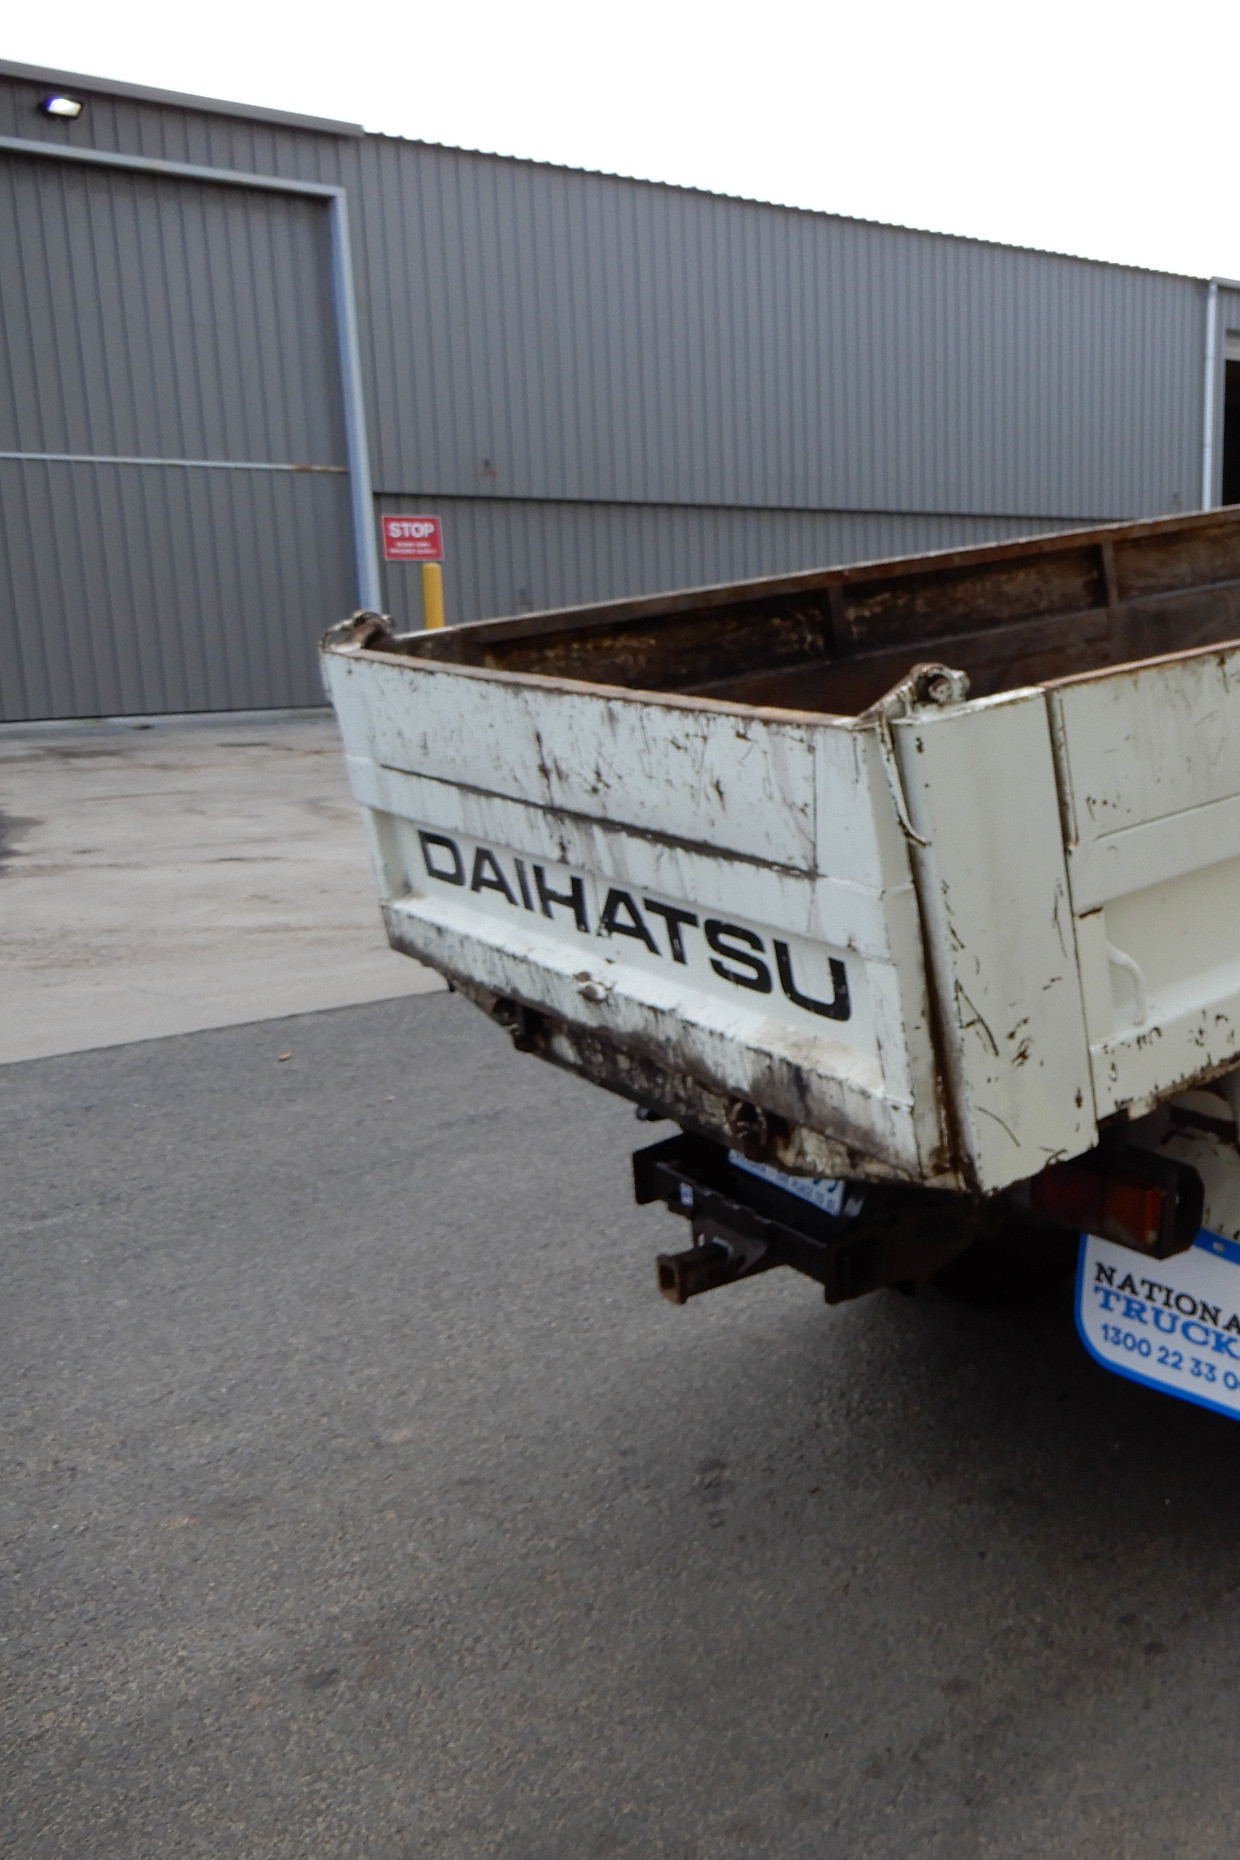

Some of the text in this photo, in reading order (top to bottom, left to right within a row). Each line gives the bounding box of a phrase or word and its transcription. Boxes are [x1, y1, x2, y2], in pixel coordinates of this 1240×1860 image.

[388, 522, 435, 538] STOP
[417, 829, 852, 1022] DAIHATSU
[1101, 1323, 1151, 1358] 1300
[1157, 1345, 1183, 1371] 22
[1190, 1357, 1216, 1382] 33
